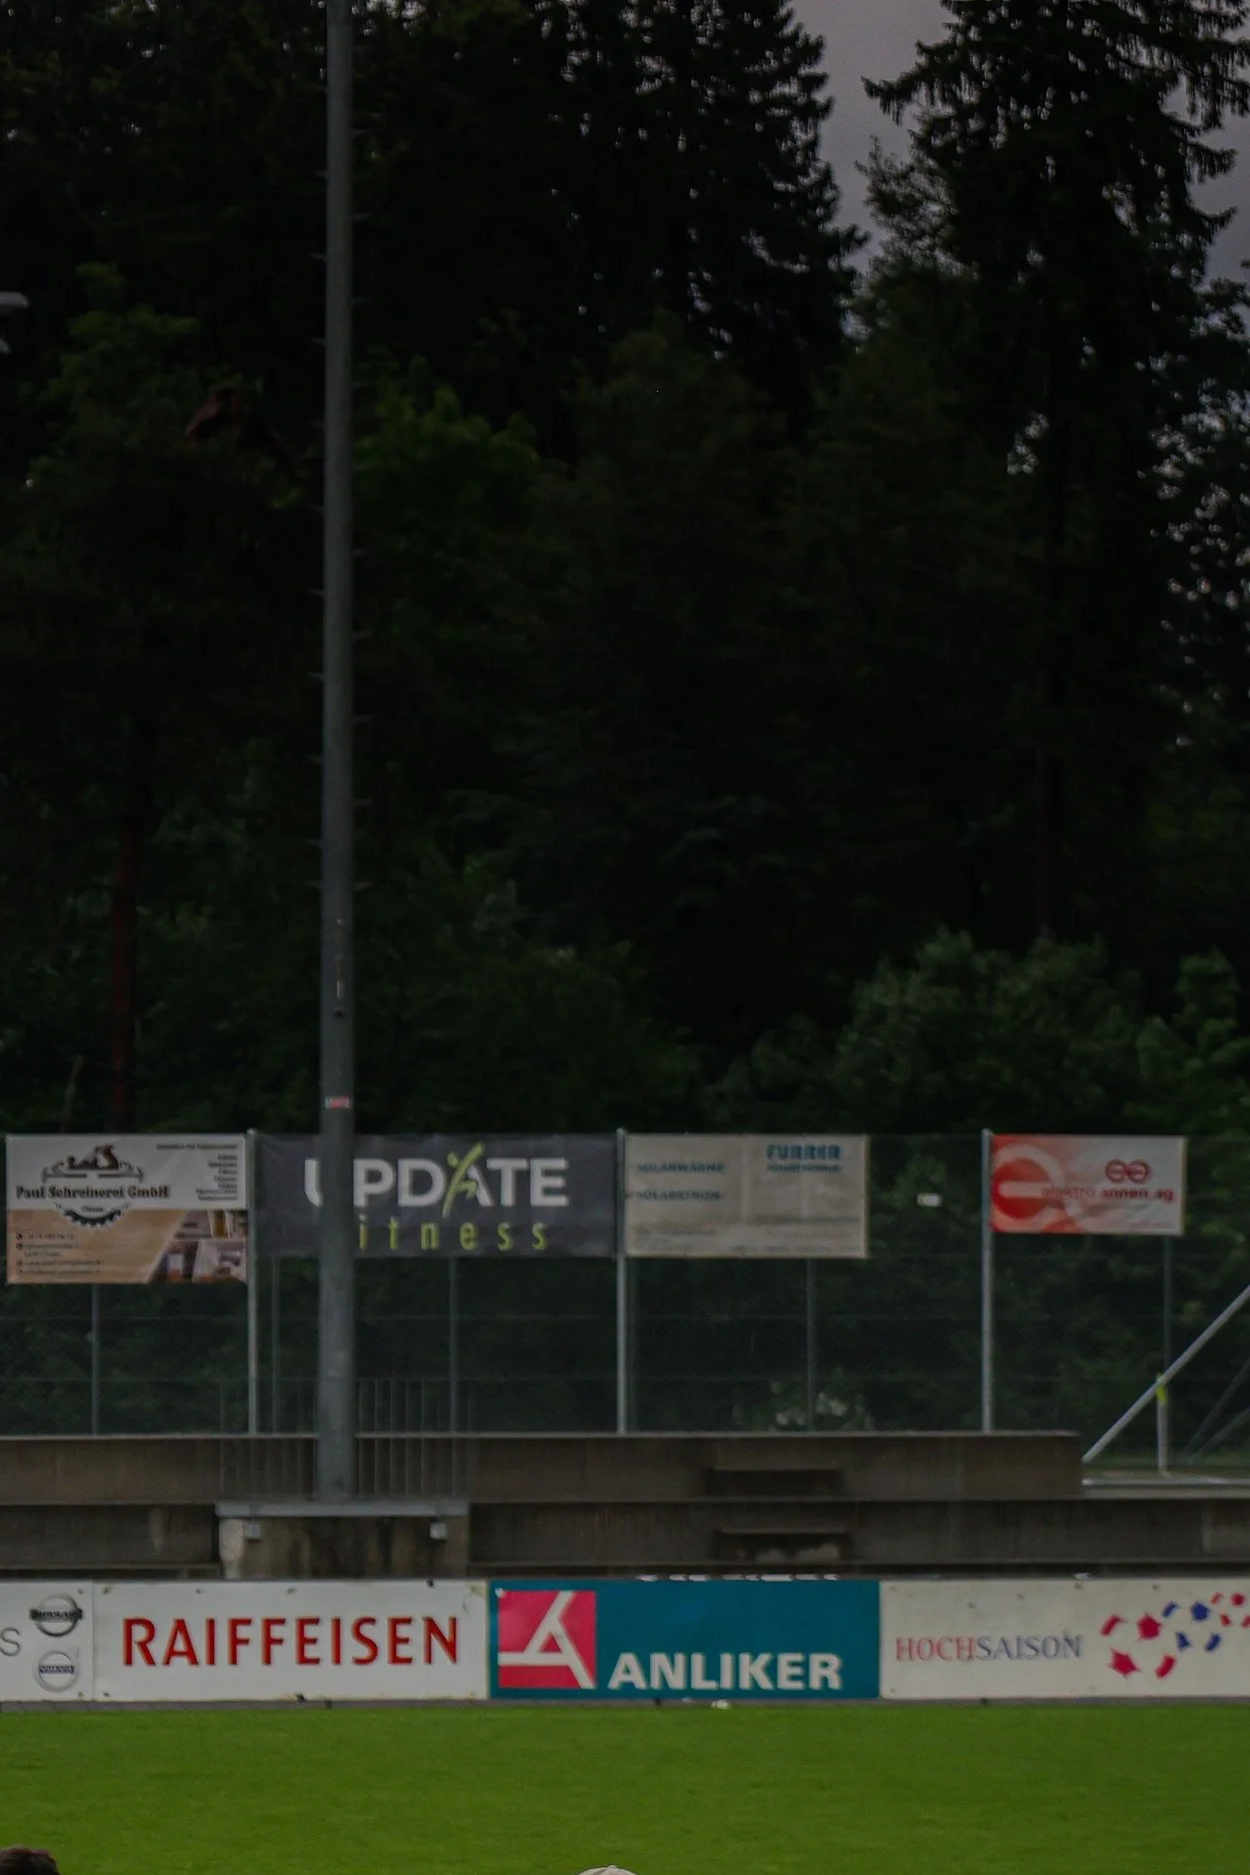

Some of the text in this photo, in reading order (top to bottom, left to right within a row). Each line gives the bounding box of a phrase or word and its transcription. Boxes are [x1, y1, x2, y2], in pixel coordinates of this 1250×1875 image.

[15, 1185, 168, 1199] Paul Schreinerei GmbH
[359, 1219, 548, 1251] itness
[122, 1617, 458, 1666] RAIFFEISEN
[895, 1635, 1082, 1662] HOCHSAISON
[607, 1651, 844, 1691] ANLIKER
